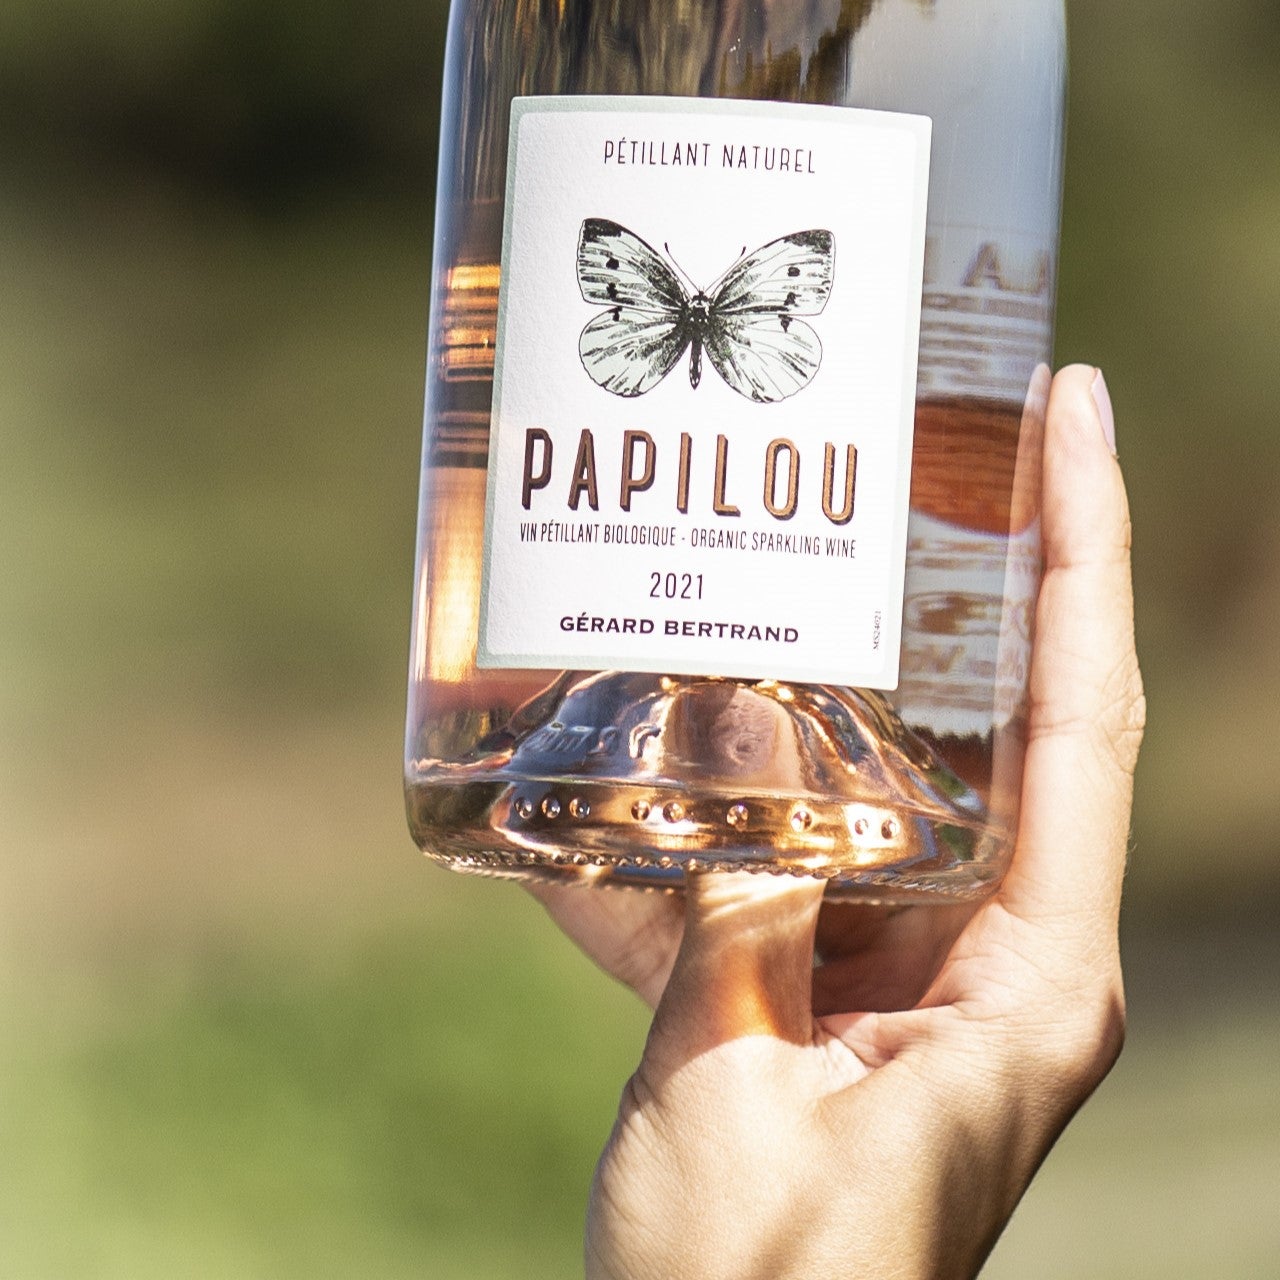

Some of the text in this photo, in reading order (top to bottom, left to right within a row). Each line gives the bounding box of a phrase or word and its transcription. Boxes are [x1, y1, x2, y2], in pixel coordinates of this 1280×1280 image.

[604, 137, 815, 174] PÉTILLANT NATUREL
[521, 428, 858, 525] PAPILOU
[520, 523, 537, 542] VIN
[540, 519, 600, 543] PÉTILLANT
[603, 524, 676, 547] BIOLOGIQUE
[691, 528, 747, 550] ORGANIC
[751, 531, 820, 556] SPARKLING
[825, 536, 856, 559] WINE
[649, 572, 703, 600] 2021
[560, 612, 799, 643] GÉRARD BERTRAND
